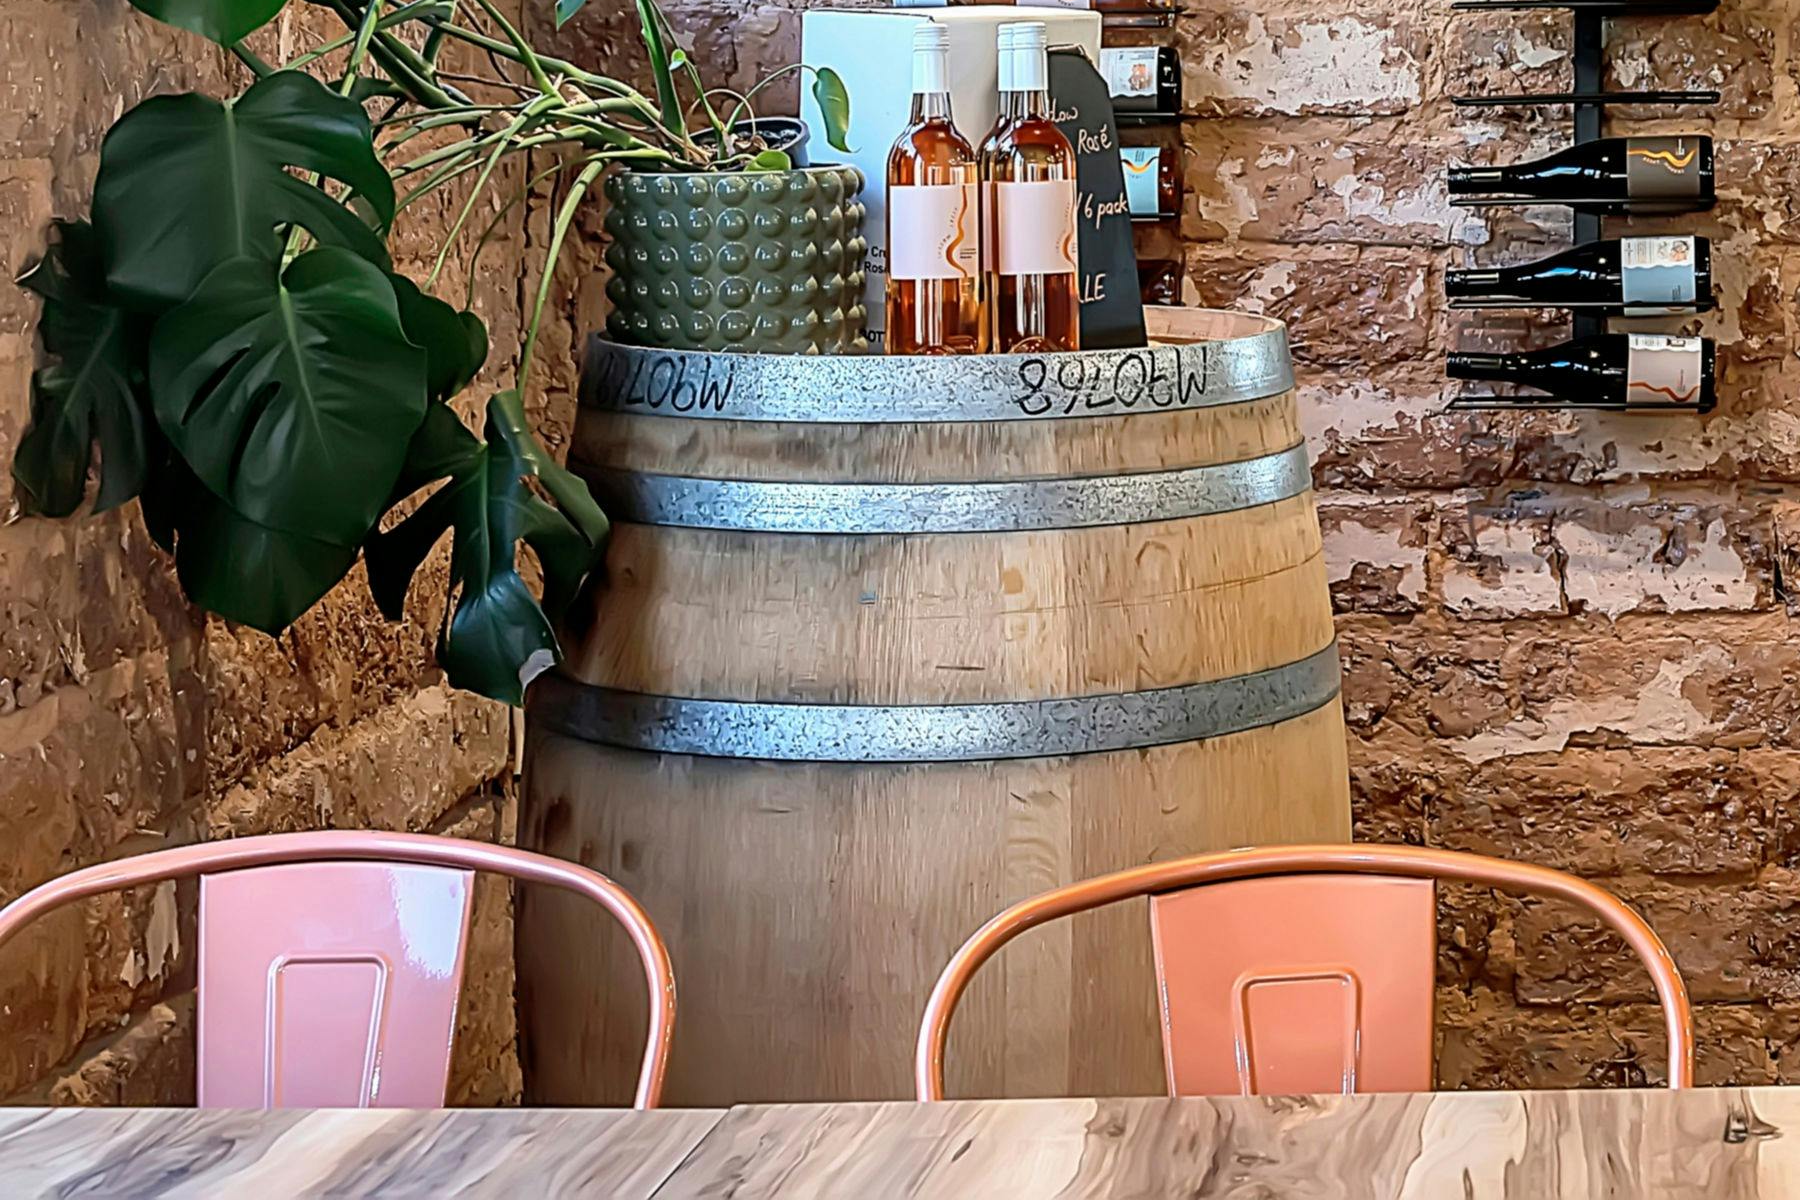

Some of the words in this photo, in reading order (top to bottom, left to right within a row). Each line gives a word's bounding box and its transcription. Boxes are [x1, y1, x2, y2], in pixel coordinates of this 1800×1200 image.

[1077, 123, 1112, 155] Rosé
[1096, 192, 1129, 230] pack
[864, 260, 888, 274] Ros
